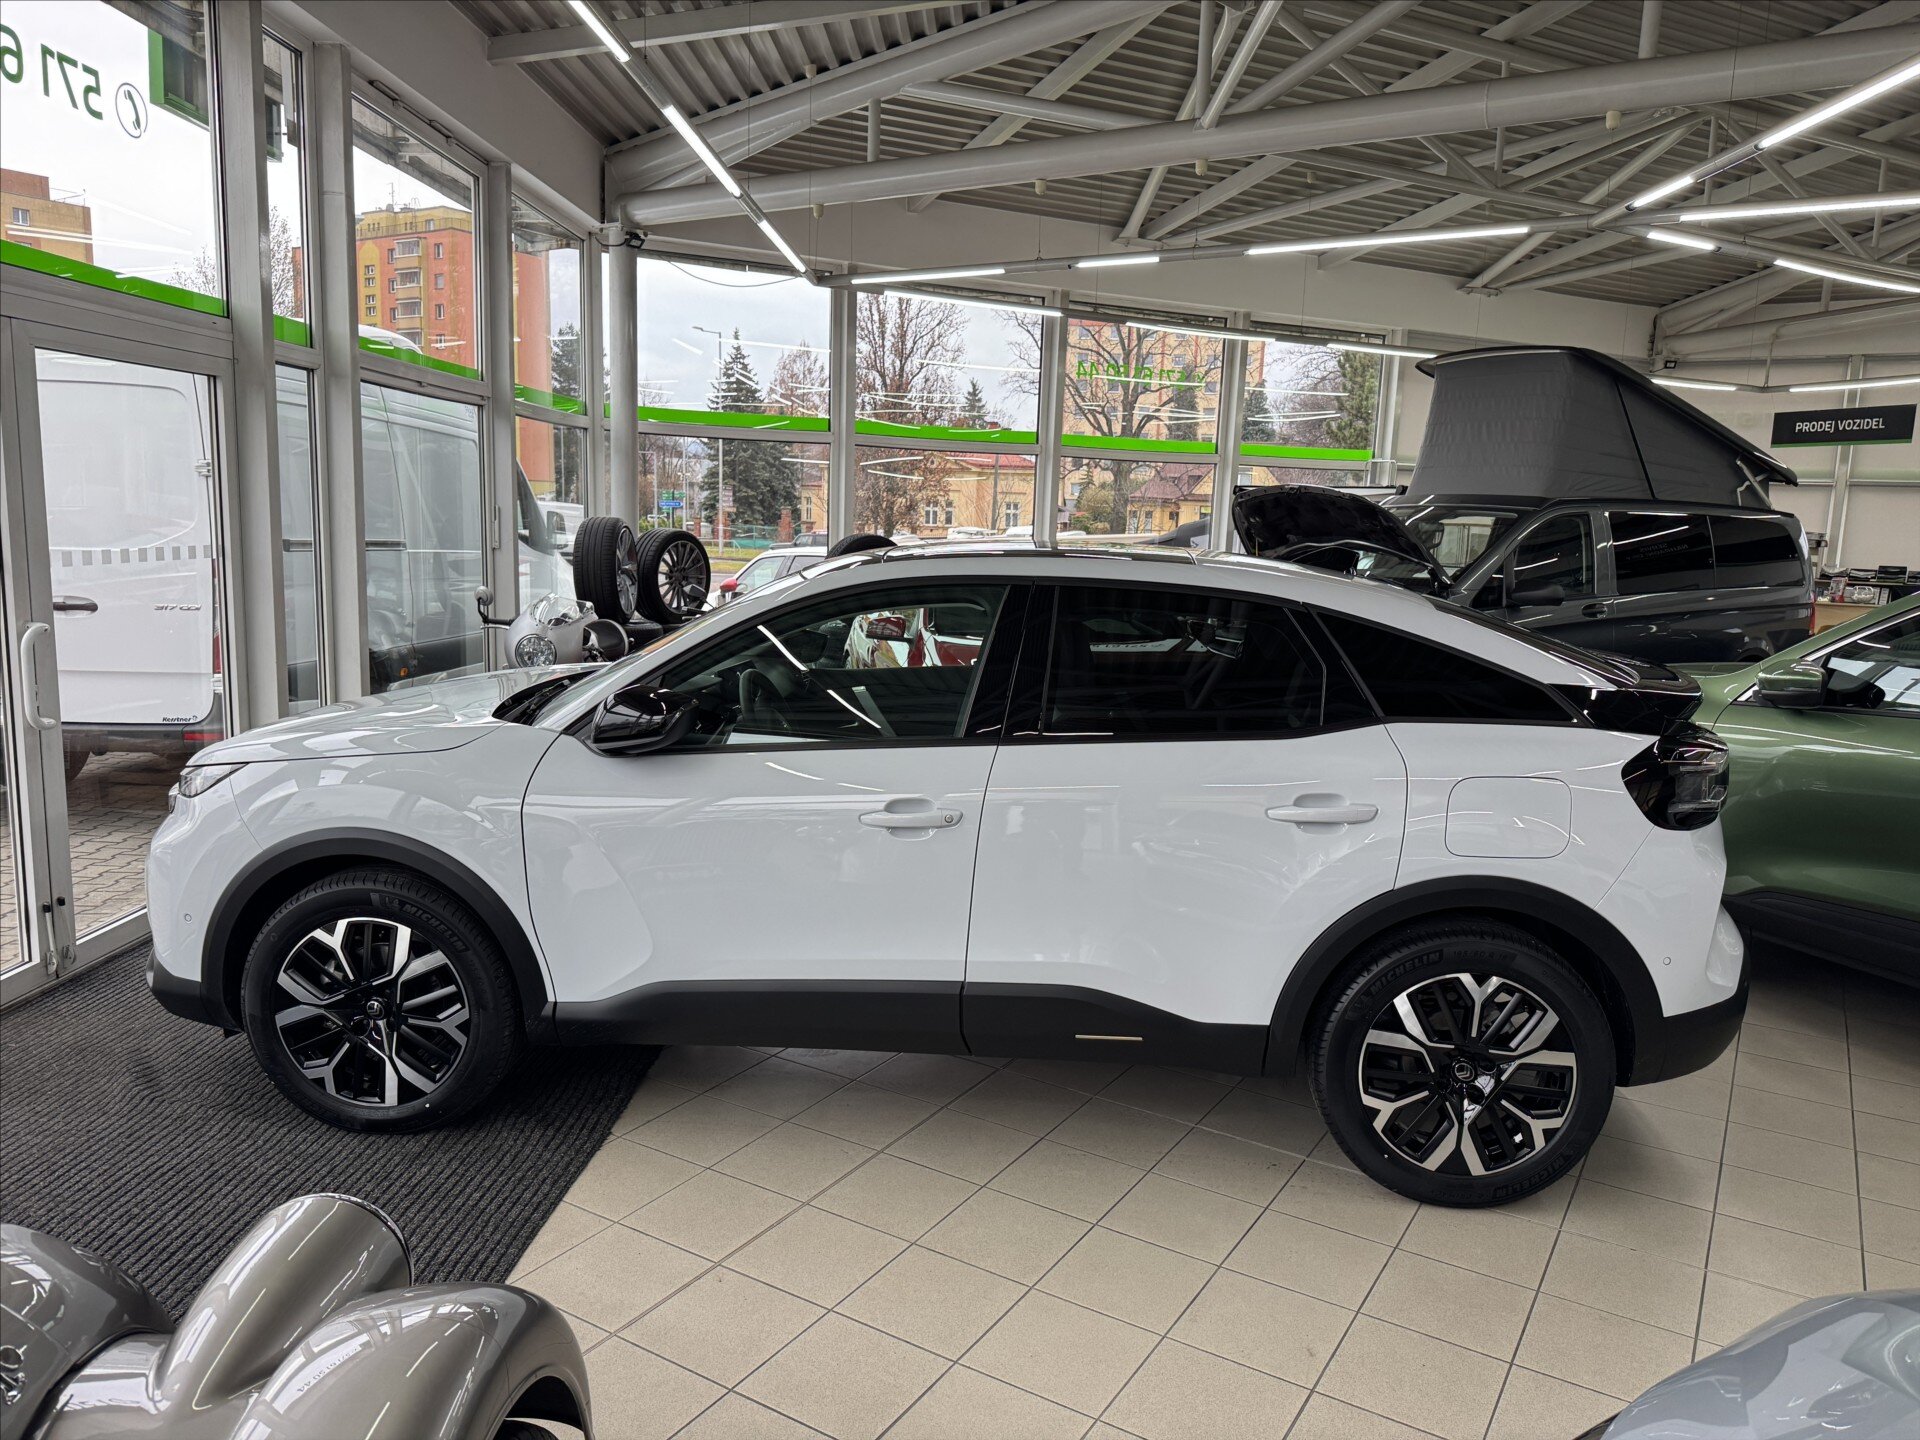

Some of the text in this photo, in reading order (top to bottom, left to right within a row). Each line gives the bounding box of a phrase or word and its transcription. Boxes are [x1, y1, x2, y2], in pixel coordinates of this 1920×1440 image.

[1795, 418, 1885, 433] PRODEJ VOZIDEL
[401, 903, 467, 952] MICHELIN
[1369, 950, 1441, 994] MICHELIN
[1492, 1156, 1566, 1200] MICHELIN
